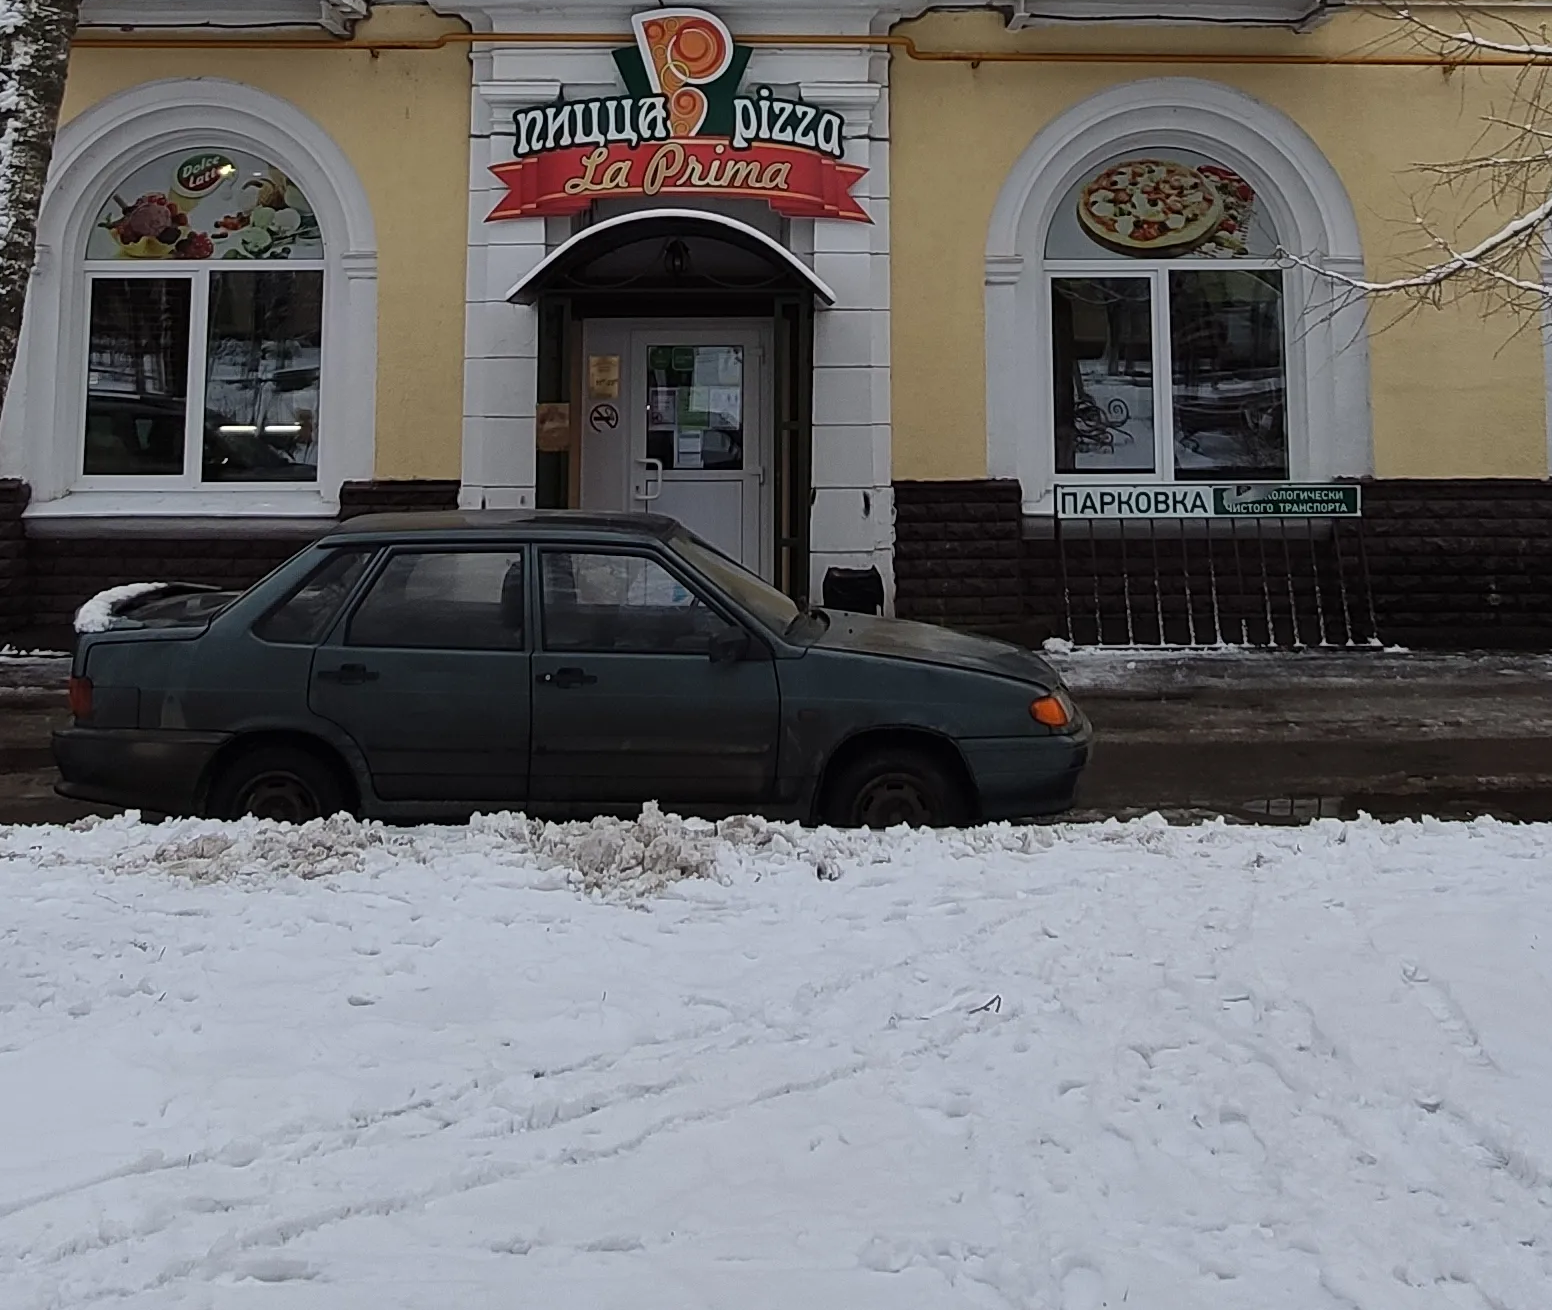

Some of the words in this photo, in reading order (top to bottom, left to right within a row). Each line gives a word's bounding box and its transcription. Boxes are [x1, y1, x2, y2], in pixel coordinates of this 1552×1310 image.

[515, 94, 669, 156] пицца
[732, 87, 844, 156] pizza
[182, 156, 221, 178] Dolce
[188, 167, 223, 188] Latt
[563, 146, 632, 195] La
[643, 142, 792, 196] Prima
[1060, 491, 1209, 515] ПАРКОВКА
[1262, 490, 1344, 501] ОЛОГИЧЕСКИ
[1226, 503, 1275, 513] ЧИСТОГО
[1278, 502, 1349, 513] ТРАНСПОРТА
